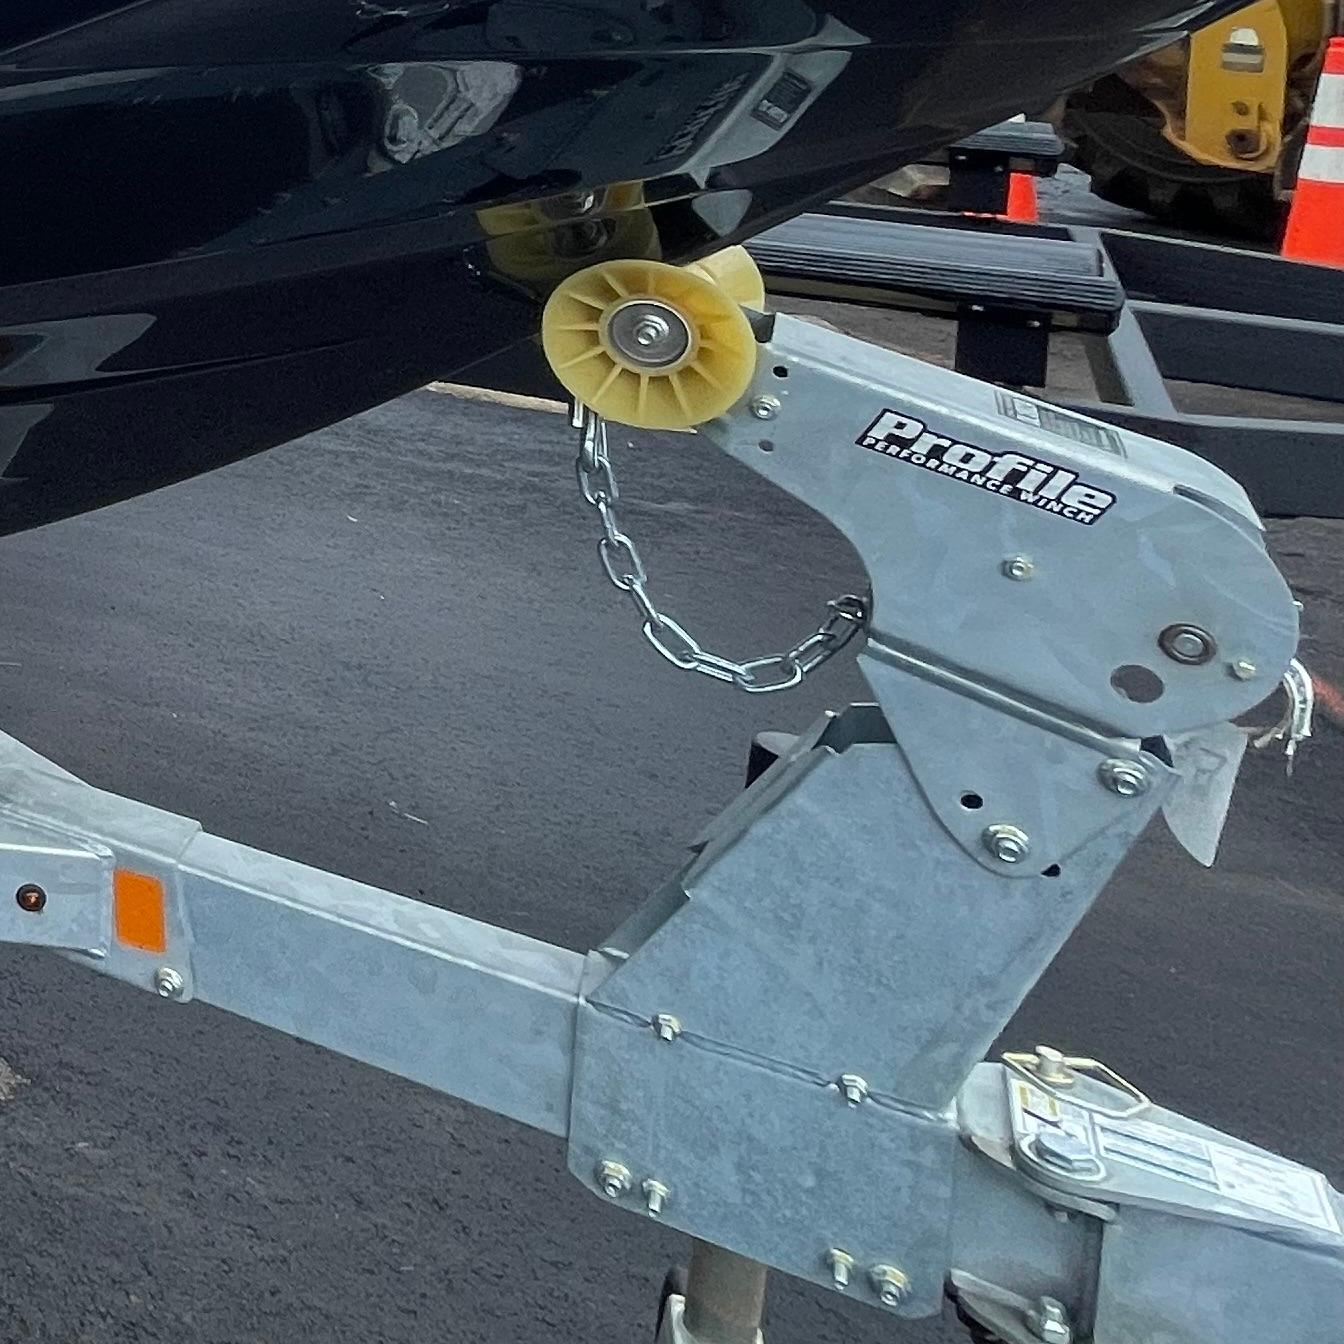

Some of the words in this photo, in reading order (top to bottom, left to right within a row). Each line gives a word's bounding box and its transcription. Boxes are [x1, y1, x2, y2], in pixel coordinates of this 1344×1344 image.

[862, 436, 1014, 496] PERFORMANCE
[1018, 490, 1095, 525] WINCH
[866, 411, 1115, 515] Profile
